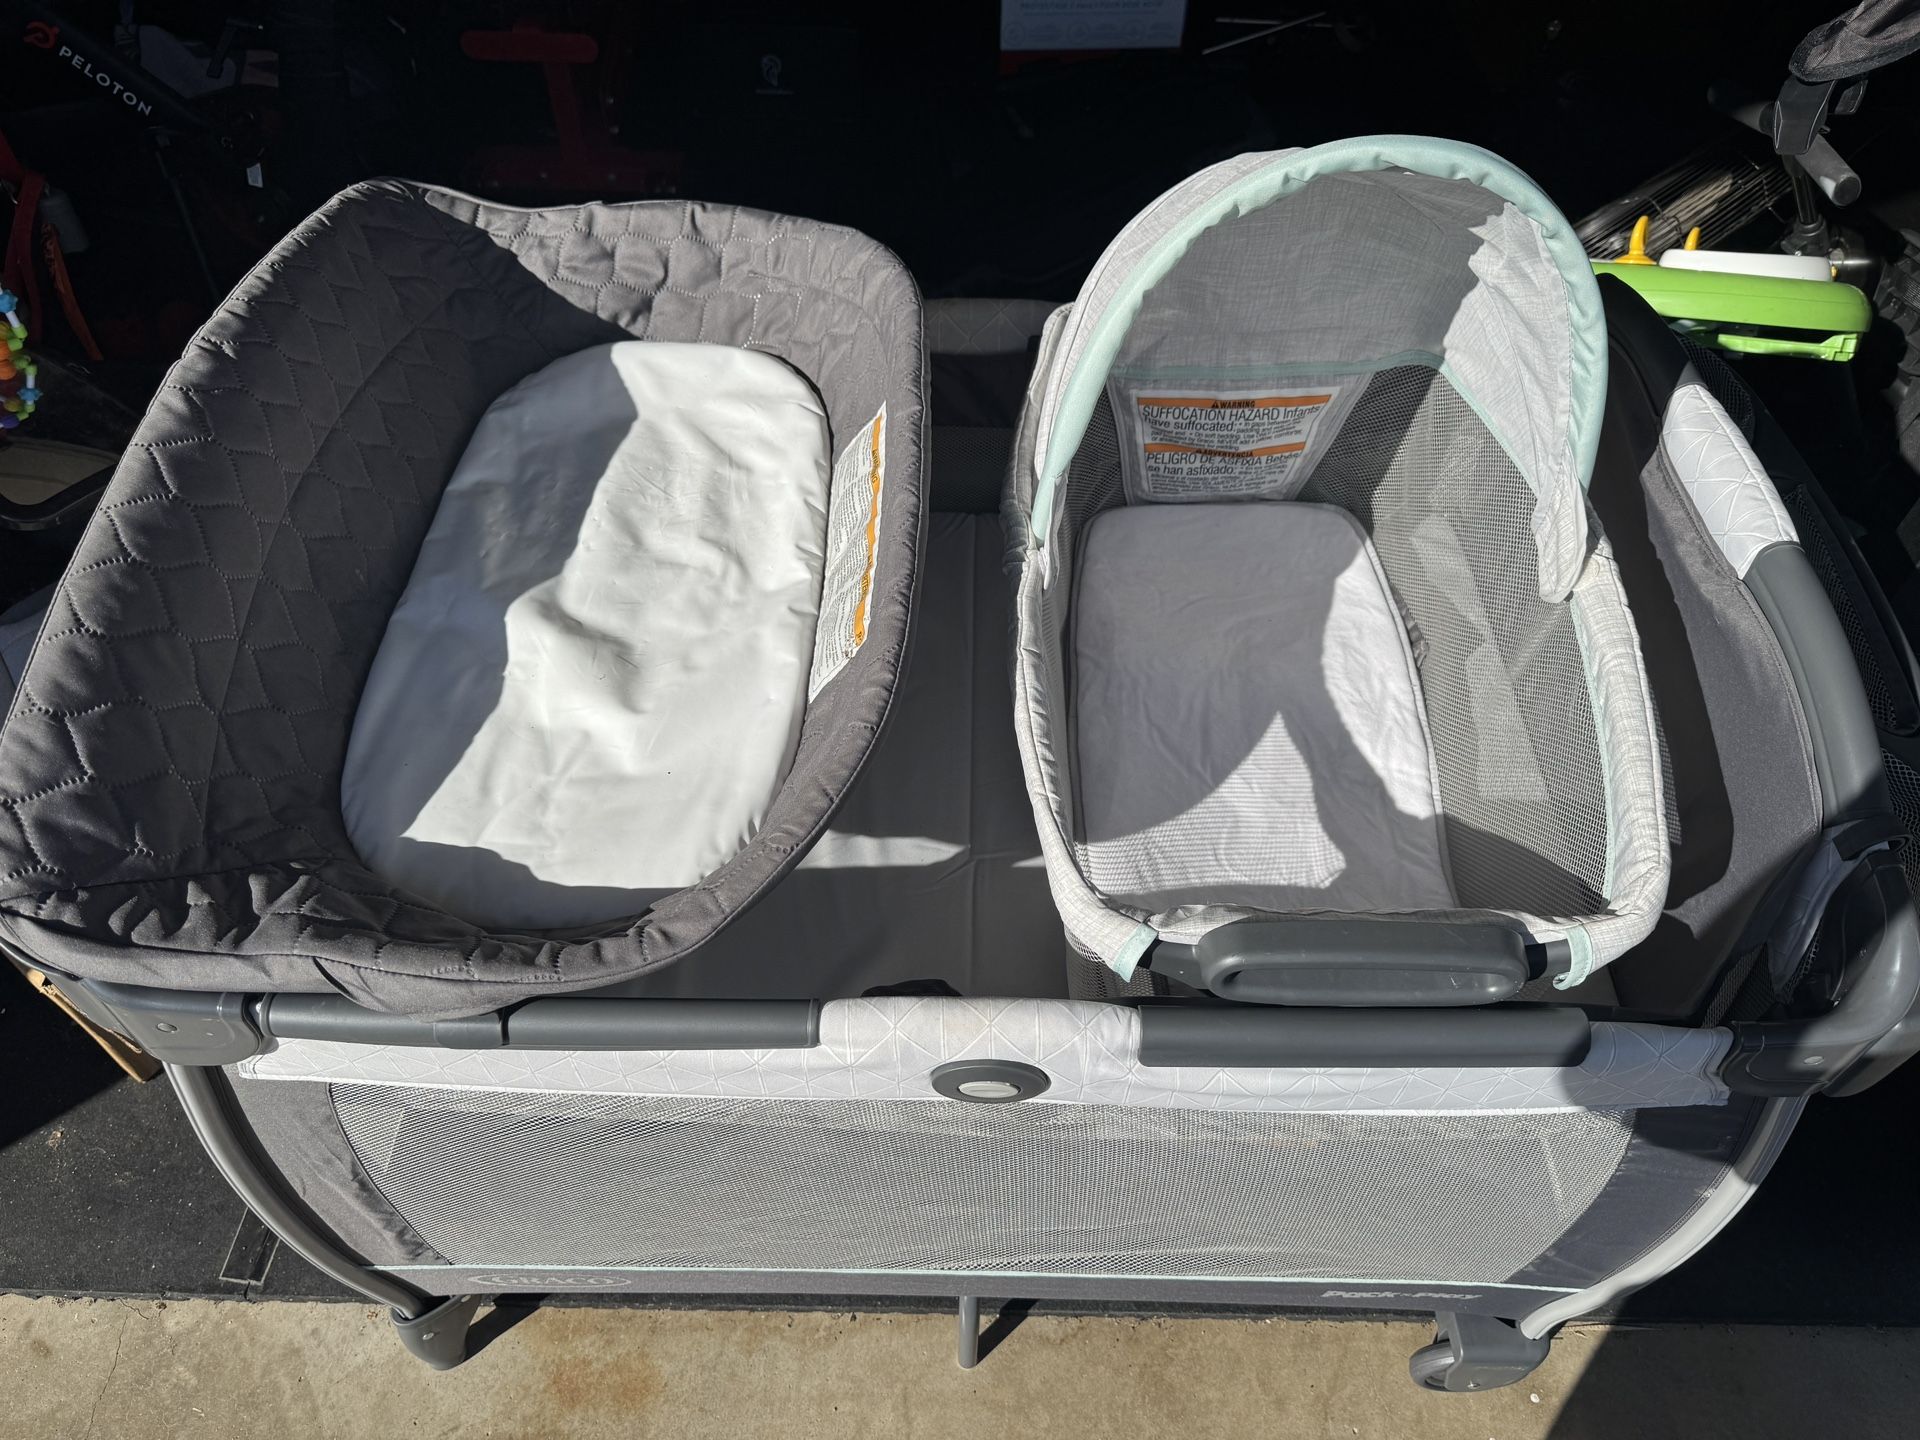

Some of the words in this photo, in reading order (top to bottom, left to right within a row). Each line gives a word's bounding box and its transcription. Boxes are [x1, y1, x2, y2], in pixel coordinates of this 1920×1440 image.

[59, 46, 152, 116] PELOTON
[1220, 400, 1256, 409] WARNING
[1142, 406, 1226, 421] SUFFOCATION
[1229, 407, 1280, 421] HAZARD
[1283, 405, 1321, 420] Infants
[1143, 414, 1171, 428] have
[1146, 453, 1197, 465] PELIGRO
[1199, 455, 1215, 464] DE
[1218, 457, 1262, 466] ASFIXIA
[1163, 465, 1184, 476] han
[491, 1276, 614, 1285] GRACO
